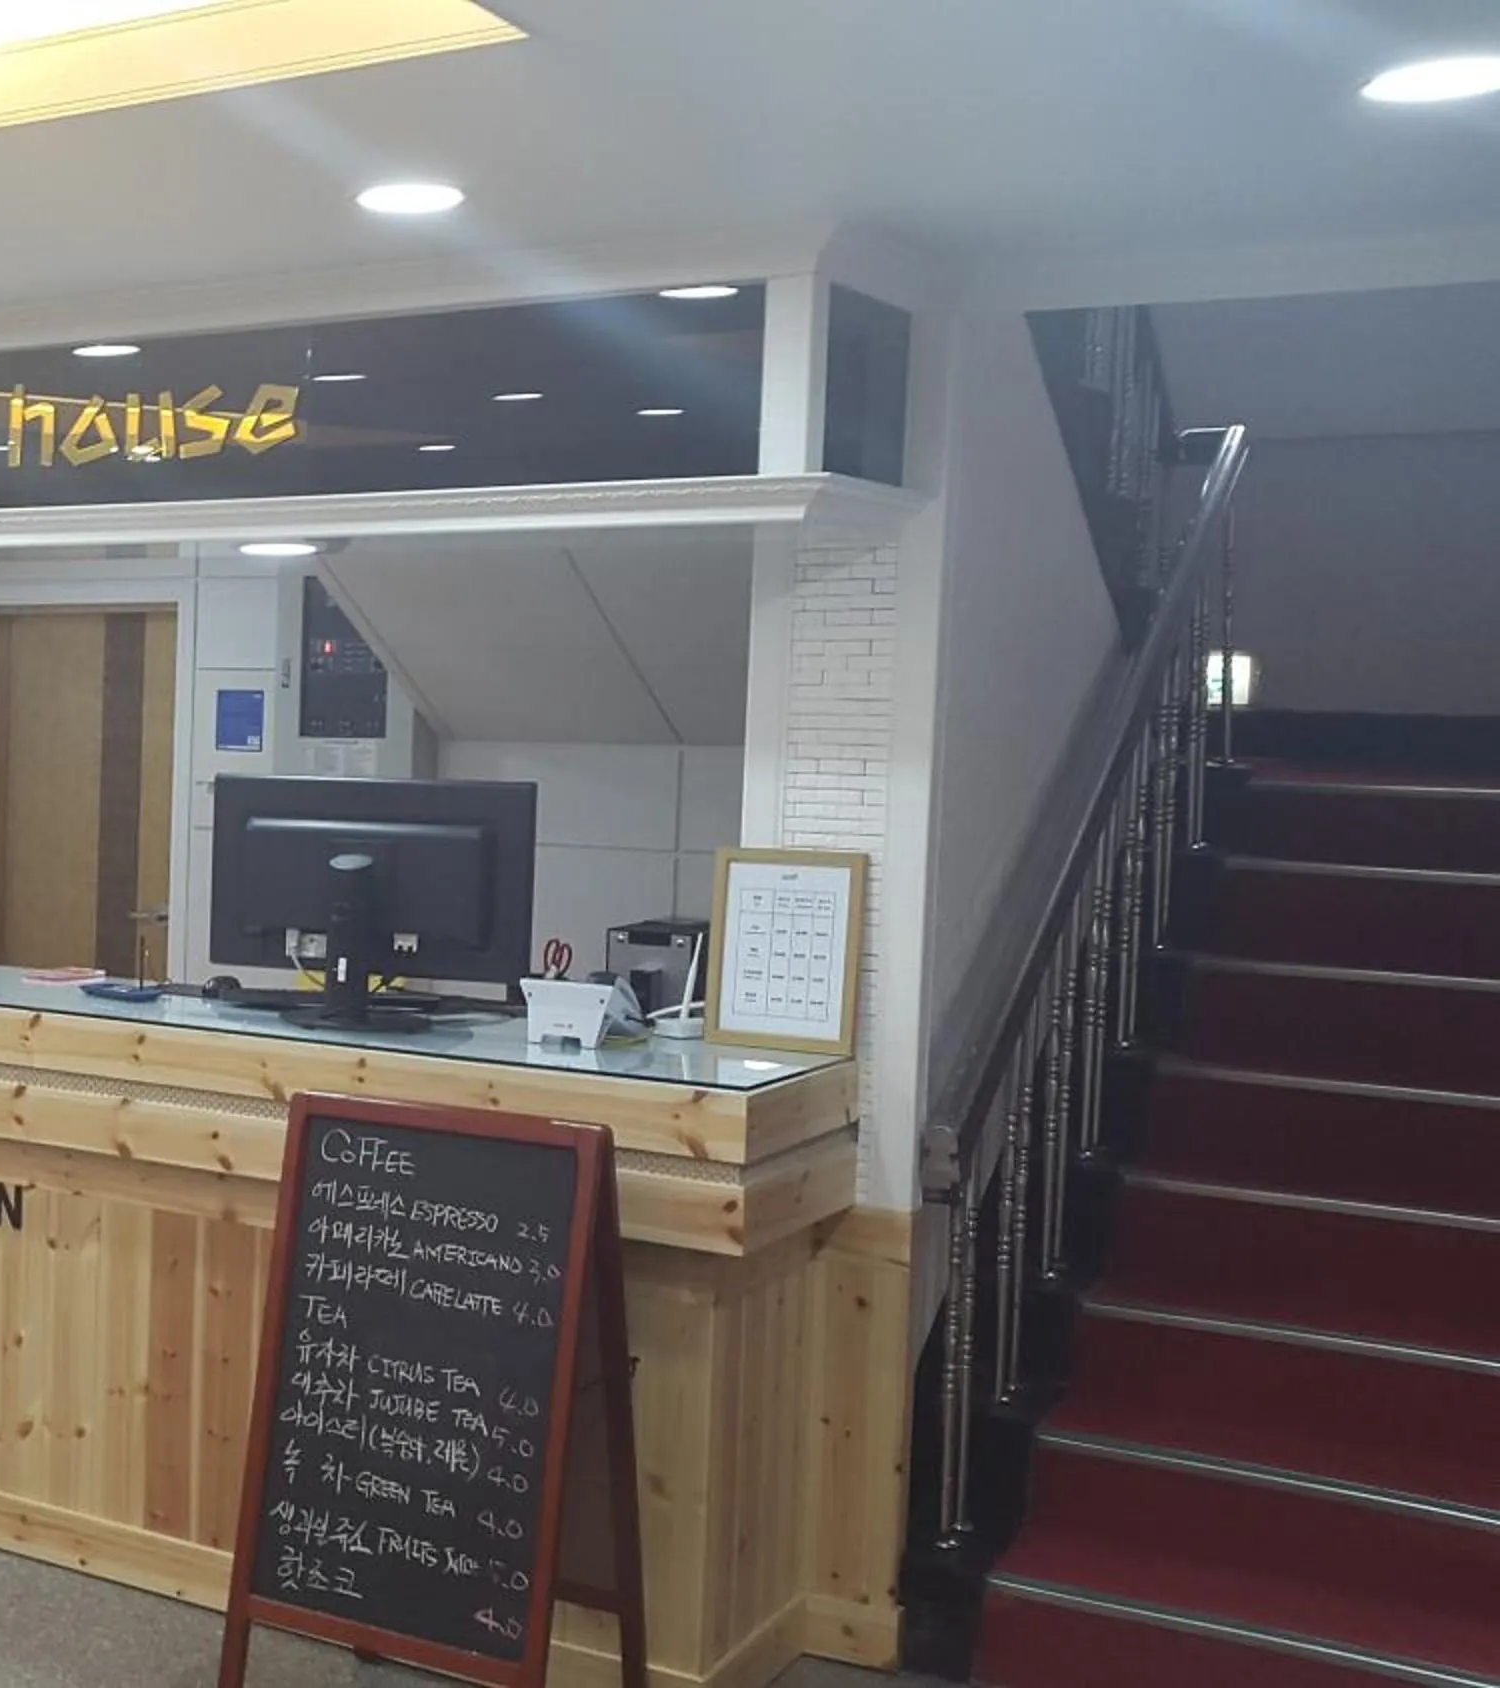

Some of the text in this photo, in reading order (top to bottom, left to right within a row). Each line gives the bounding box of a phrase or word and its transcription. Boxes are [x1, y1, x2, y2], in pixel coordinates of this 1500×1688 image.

[7, 384, 299, 467] house
[307, 1215, 562, 1286] 아메리카노 AMERICANO 3.0
[410, 1199, 499, 1233] ESPRESSO
[516, 1221, 550, 1243] 2.5
[299, 1294, 347, 1329] TEA
[512, 1301, 554, 1328] 4.0
[295, 1328, 539, 1416] 유자차 CITRUS TEA 4.0
[291, 1370, 534, 1458] 대추차 JUJUBE TEA 5.0
[355, 1471, 411, 1505] GREEN
[420, 1488, 456, 1518] TEA
[477, 1509, 523, 1539] 4.0
[487, 1465, 529, 1493] 4.0
[277, 1544, 523, 1640] 핫초코 4.0
